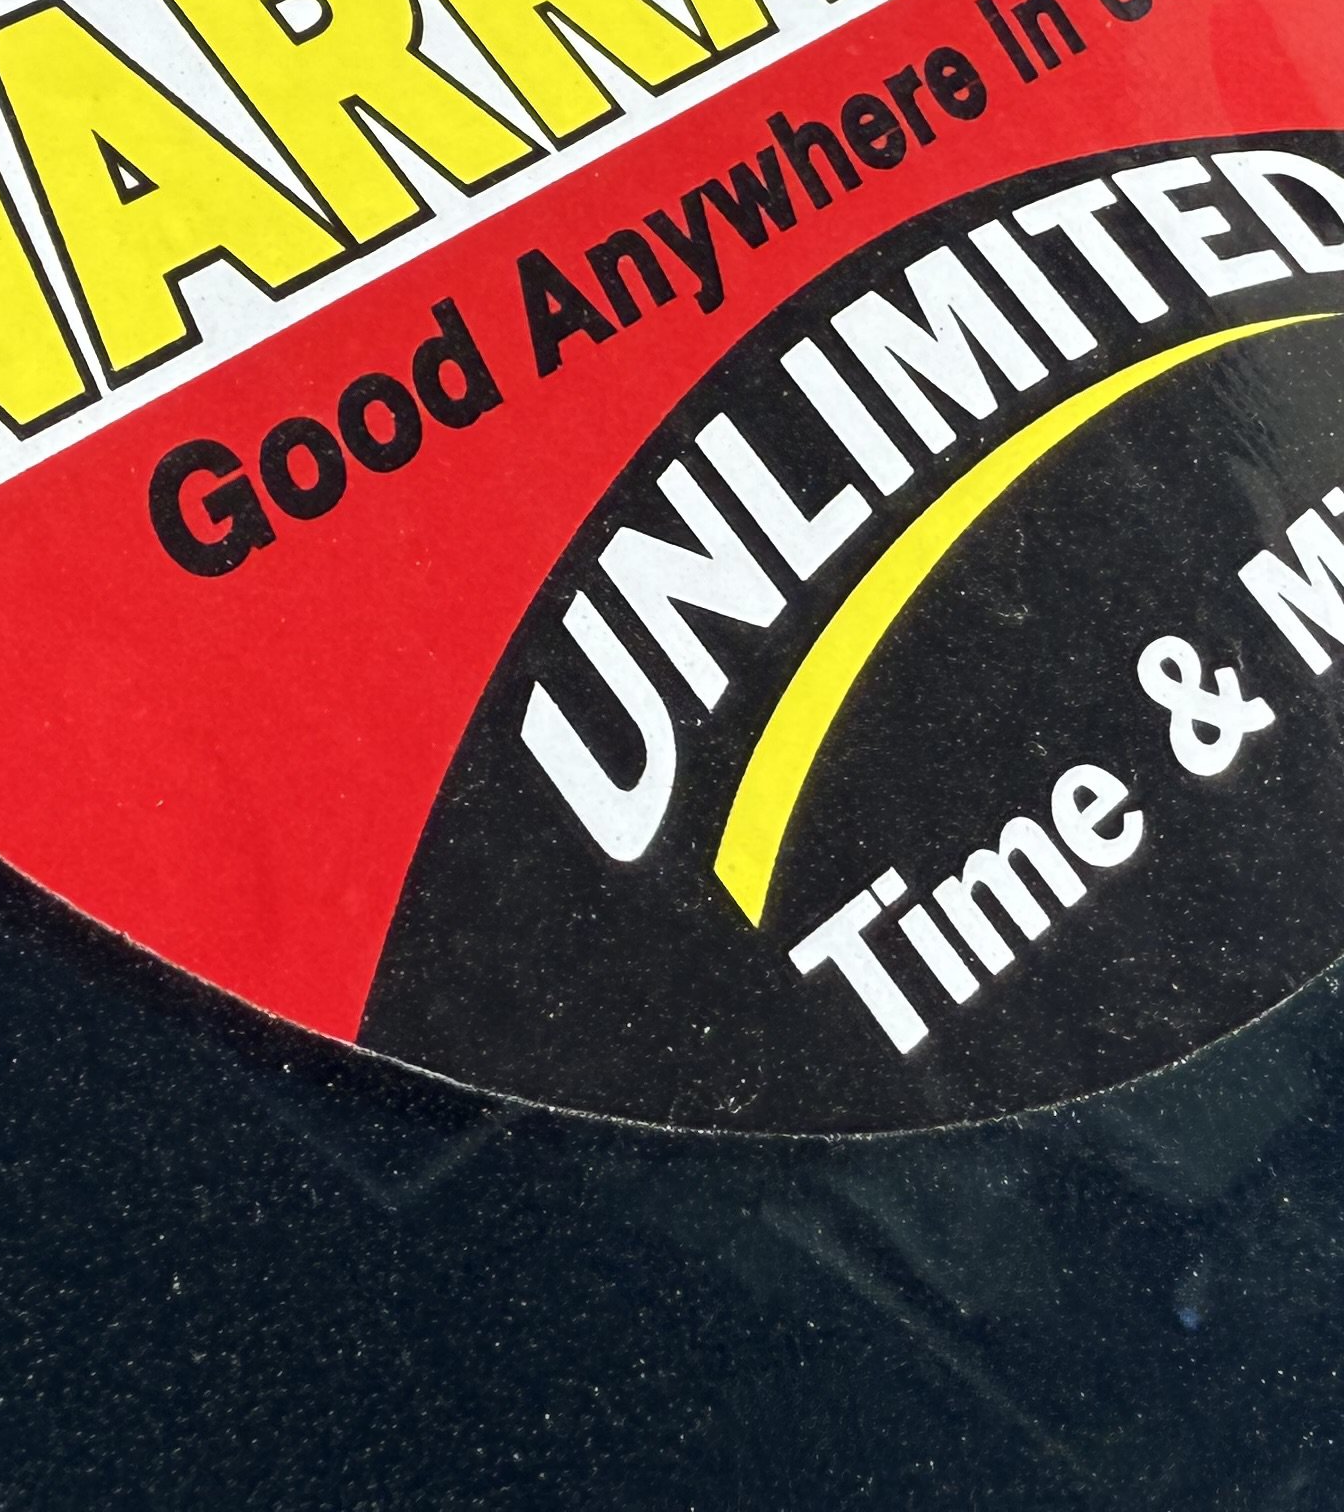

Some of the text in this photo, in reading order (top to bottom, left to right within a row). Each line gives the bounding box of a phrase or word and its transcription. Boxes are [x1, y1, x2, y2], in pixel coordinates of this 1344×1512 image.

[147, 299, 499, 579] Good
[520, 43, 987, 379] Anywhere
[788, 761, 1147, 1055] Time
[1137, 634, 1277, 778] &
